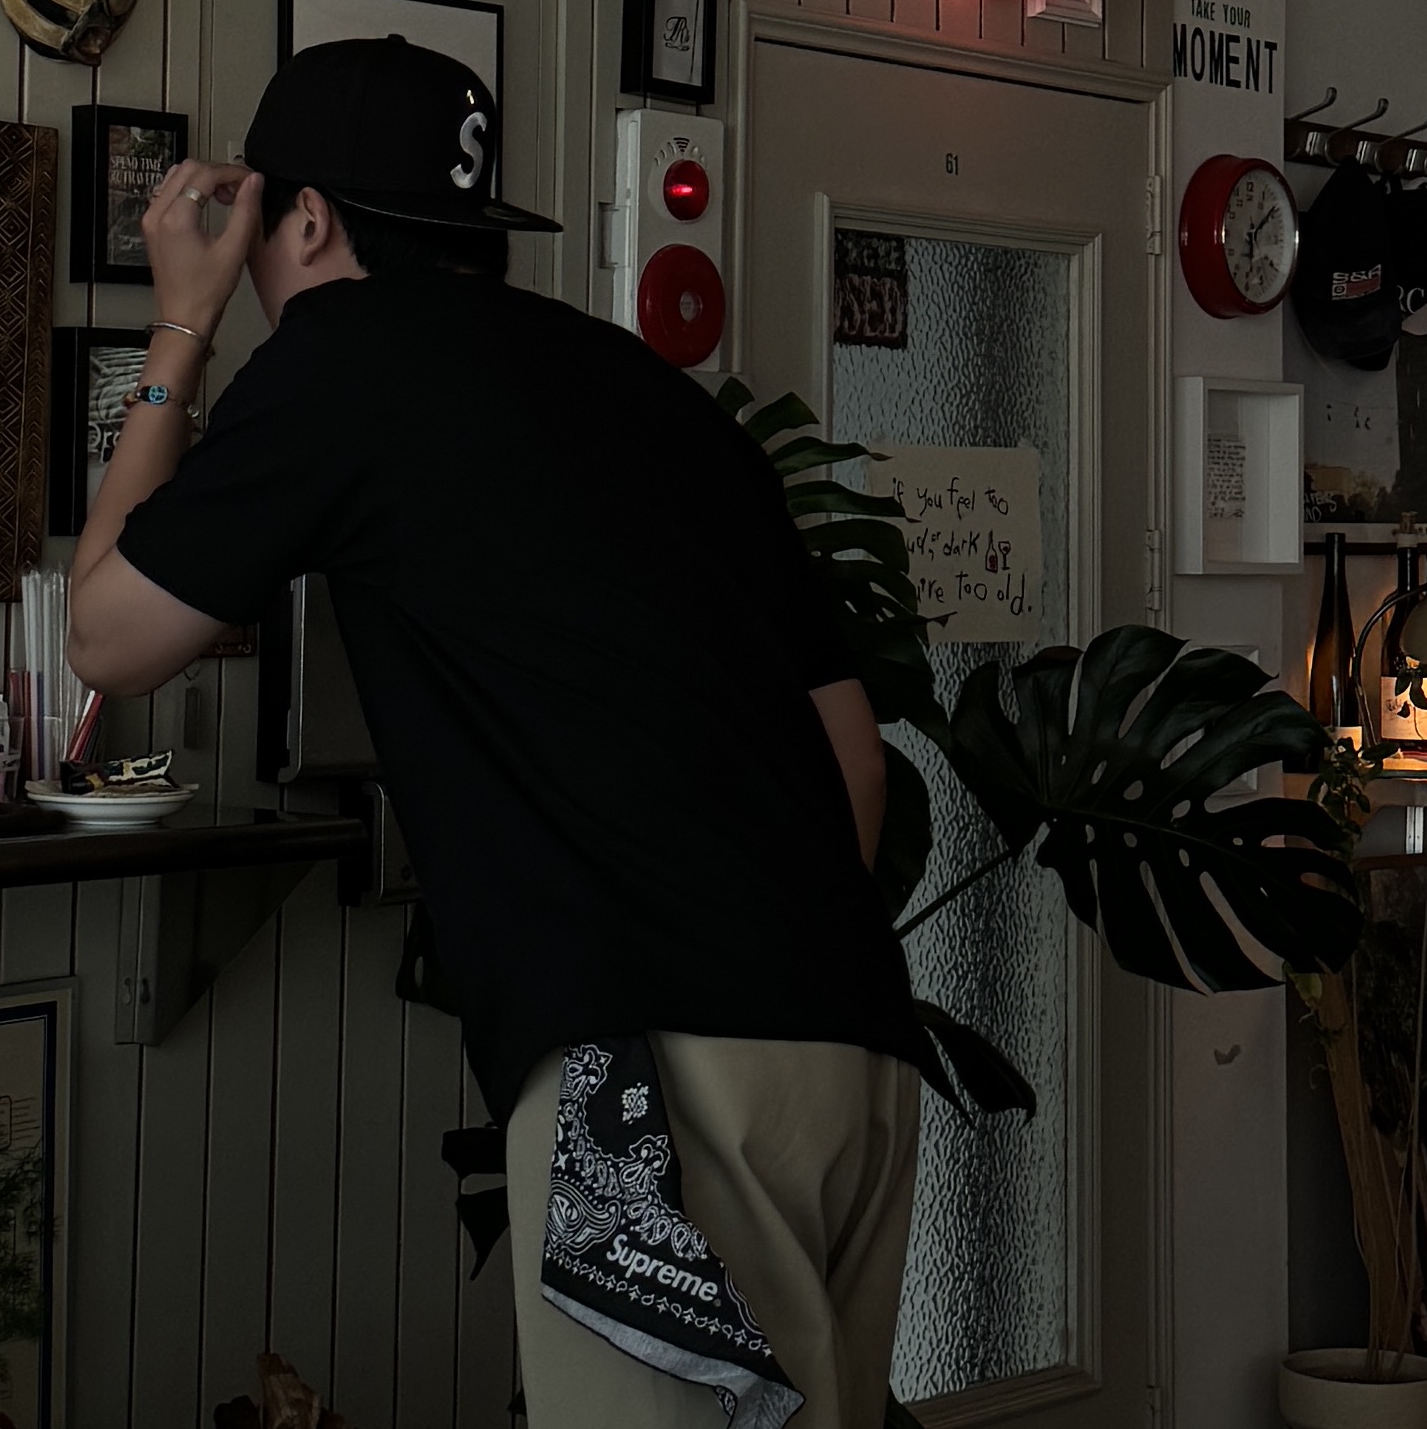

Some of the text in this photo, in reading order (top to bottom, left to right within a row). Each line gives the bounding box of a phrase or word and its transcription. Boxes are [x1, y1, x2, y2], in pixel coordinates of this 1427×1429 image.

[1223, 3, 1251, 29] YOUR
[1173, 23, 1279, 94] MOMENT
[450, 112, 488, 189] S
[945, 153, 959, 174] 61
[916, 487, 943, 516] you
[943, 530, 980, 557] dark
[606, 1233, 719, 1302] Supreme
